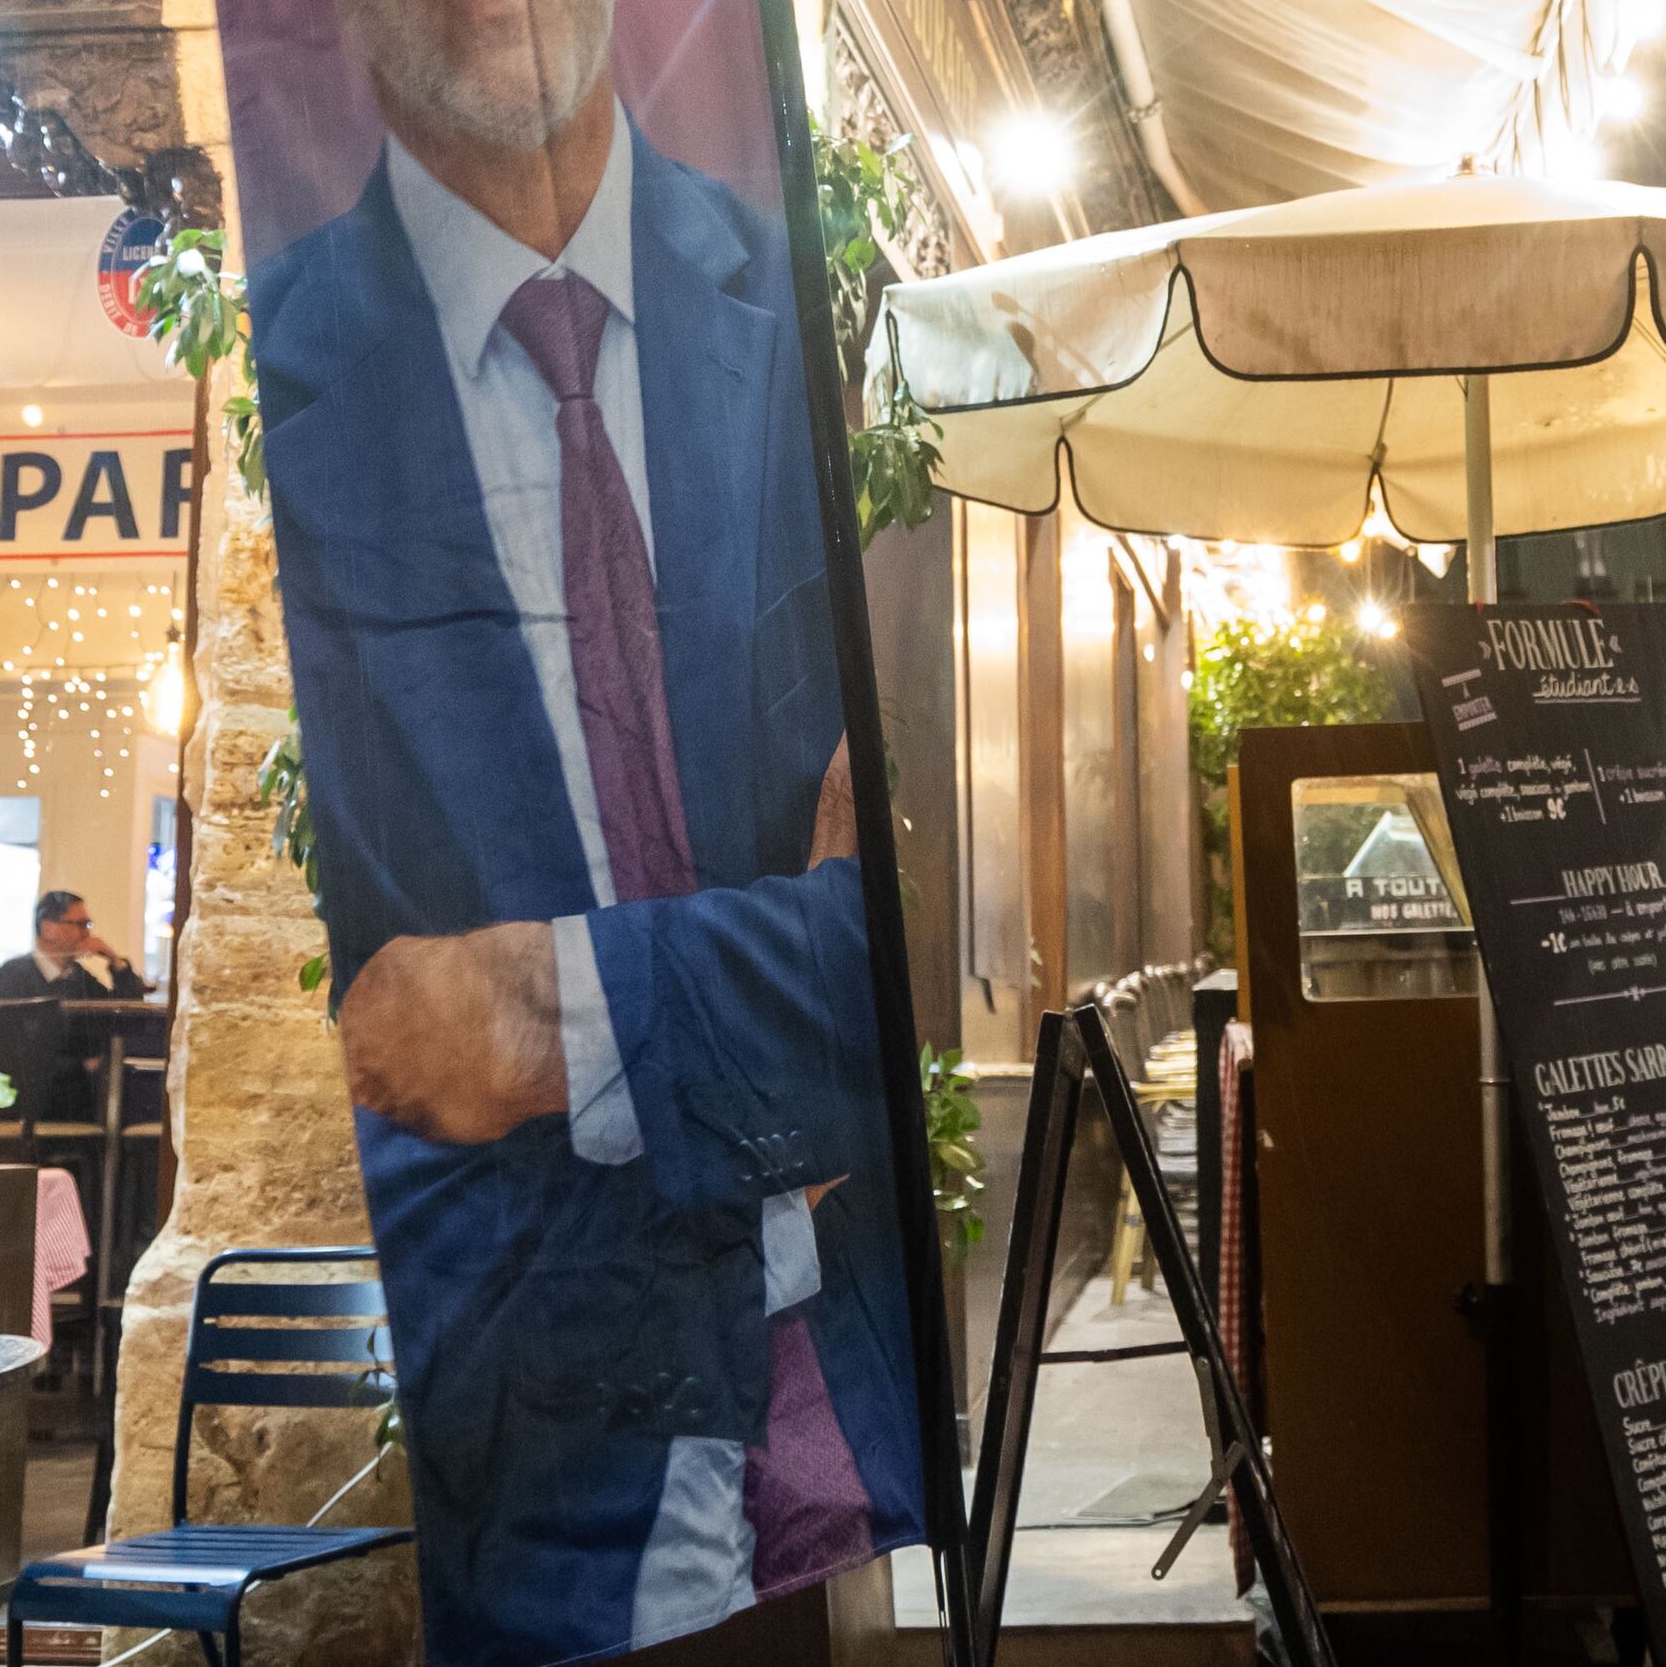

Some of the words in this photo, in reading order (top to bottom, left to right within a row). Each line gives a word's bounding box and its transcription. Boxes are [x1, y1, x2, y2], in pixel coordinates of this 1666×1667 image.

[1486, 619, 1615, 670] FORMULE
[1561, 866, 1617, 899] HAPPY
[1616, 860, 1663, 893] HOUR
[1402, 900, 1458, 920] GALETTE
